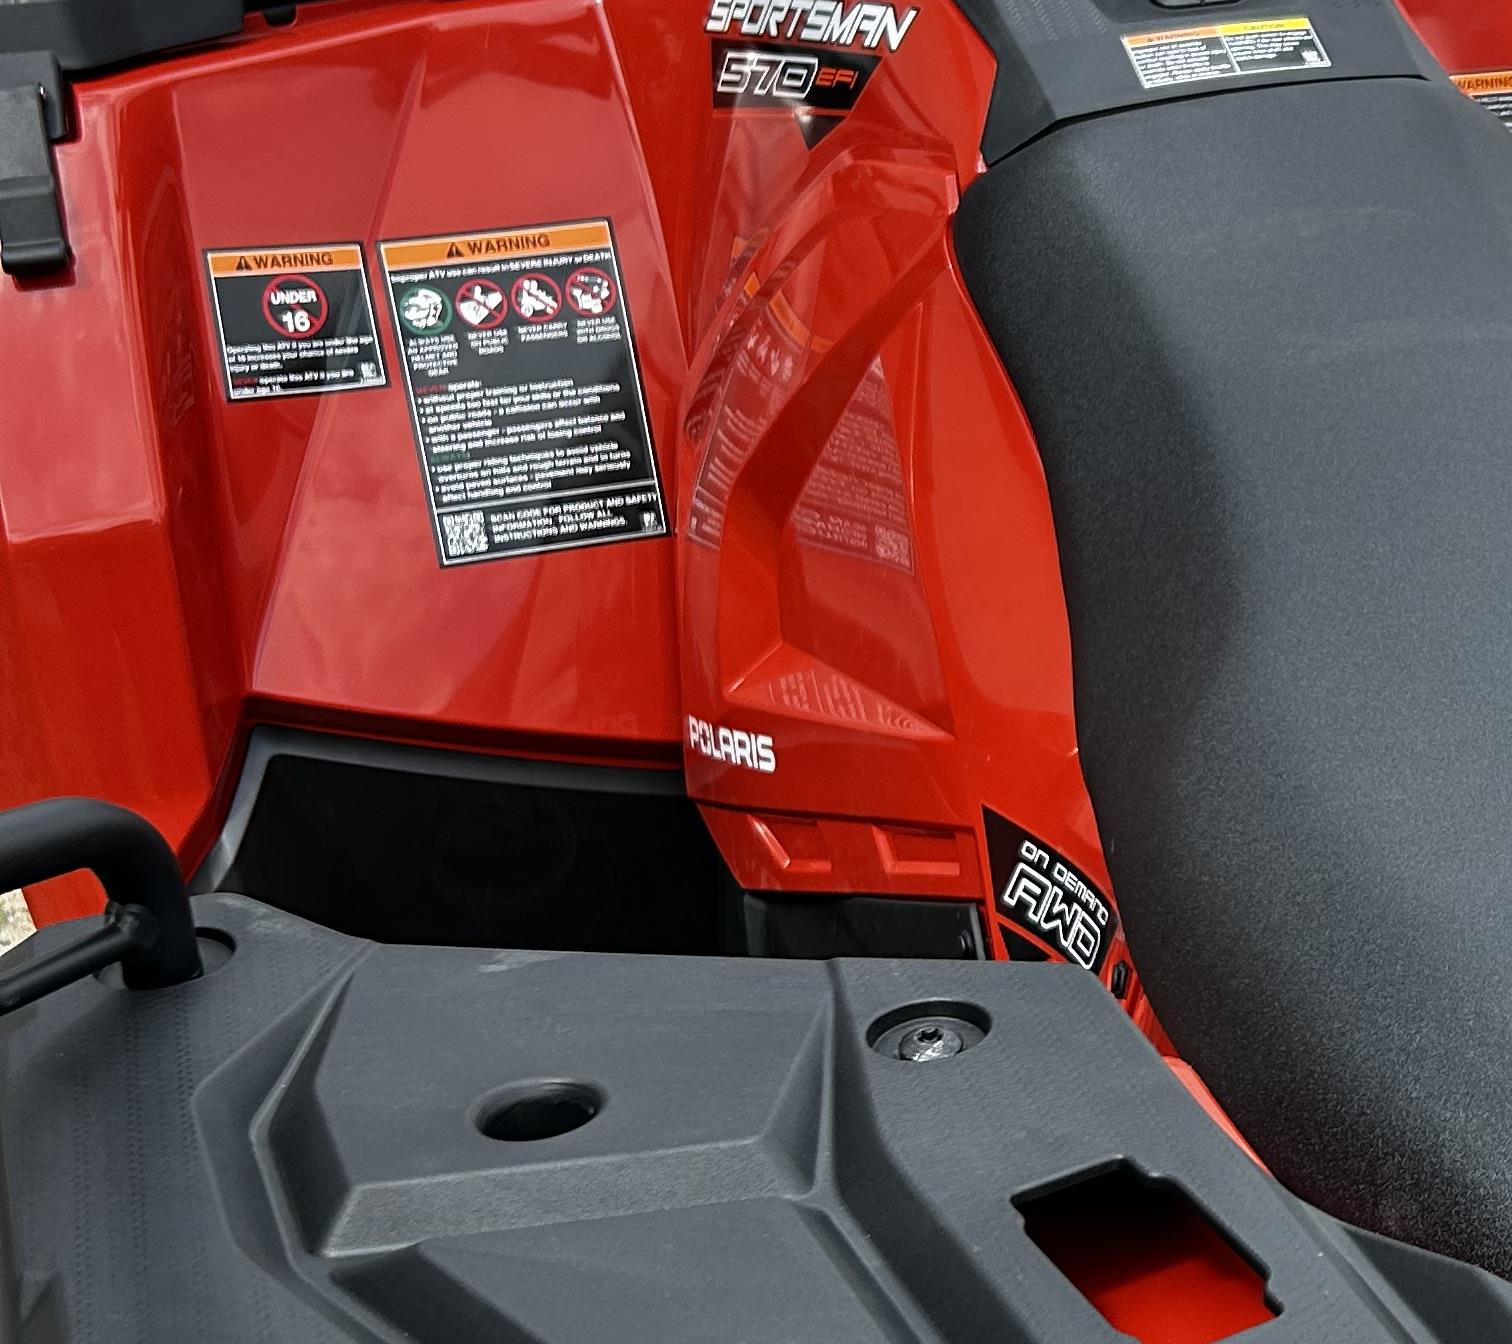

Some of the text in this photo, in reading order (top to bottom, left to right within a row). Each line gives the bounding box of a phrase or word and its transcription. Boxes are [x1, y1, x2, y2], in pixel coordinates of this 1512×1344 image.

[716, 51, 860, 99] 570 EFI
[253, 252, 334, 270] WARNING
[467, 233, 551, 256] WARNING
[270, 288, 317, 305] UNDER
[282, 310, 311, 333] 16
[688, 714, 776, 774] POLARIS
[1020, 839, 1109, 926] ON DEMAND
[1003, 861, 1101, 970] AWD
